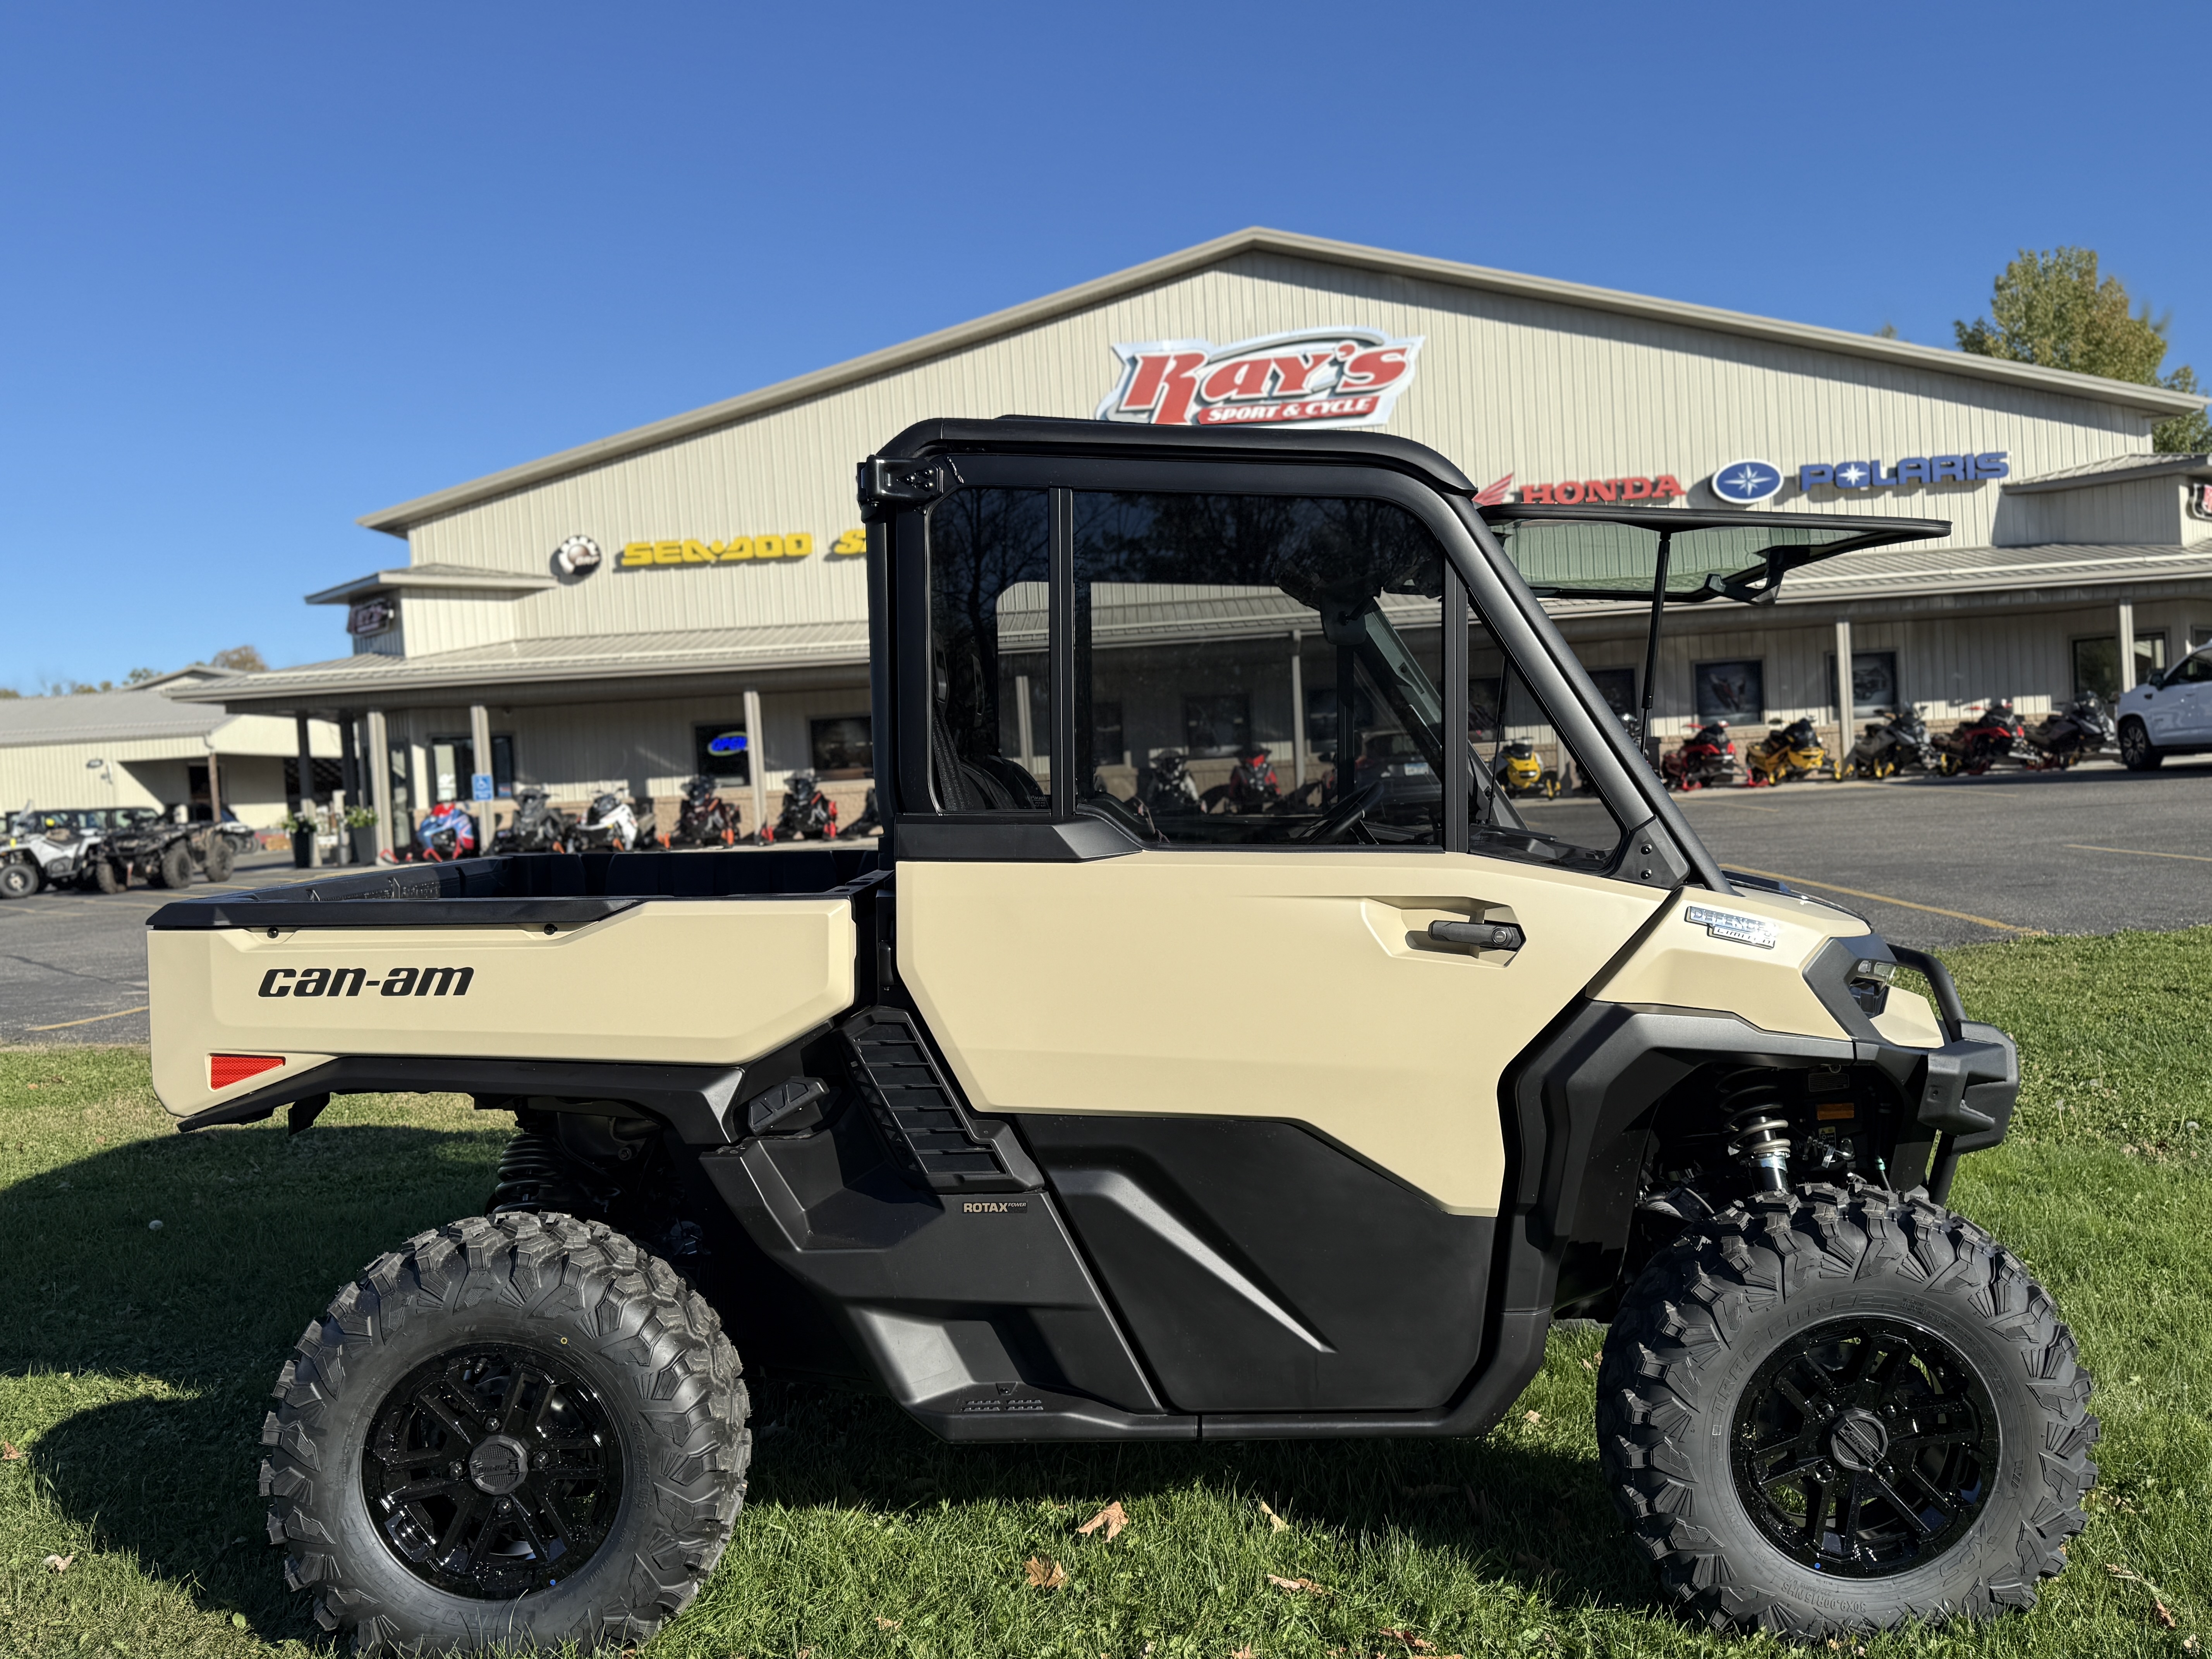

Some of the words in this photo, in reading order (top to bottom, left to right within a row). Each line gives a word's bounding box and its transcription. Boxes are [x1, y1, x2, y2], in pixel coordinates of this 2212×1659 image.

[1121, 342, 1415, 424] Ray's
[1207, 406, 1279, 421] SPORT
[1283, 404, 1301, 416] &
[1305, 398, 1372, 414] CYCLE
[1800, 452, 2009, 491] POLARIS
[1520, 475, 1686, 505] HONDA
[711, 736, 748, 751] OPEN
[1691, 908, 1777, 936] DEFENDE
[258, 967, 474, 997] can-am
[964, 1203, 1008, 1212] ROTAX
